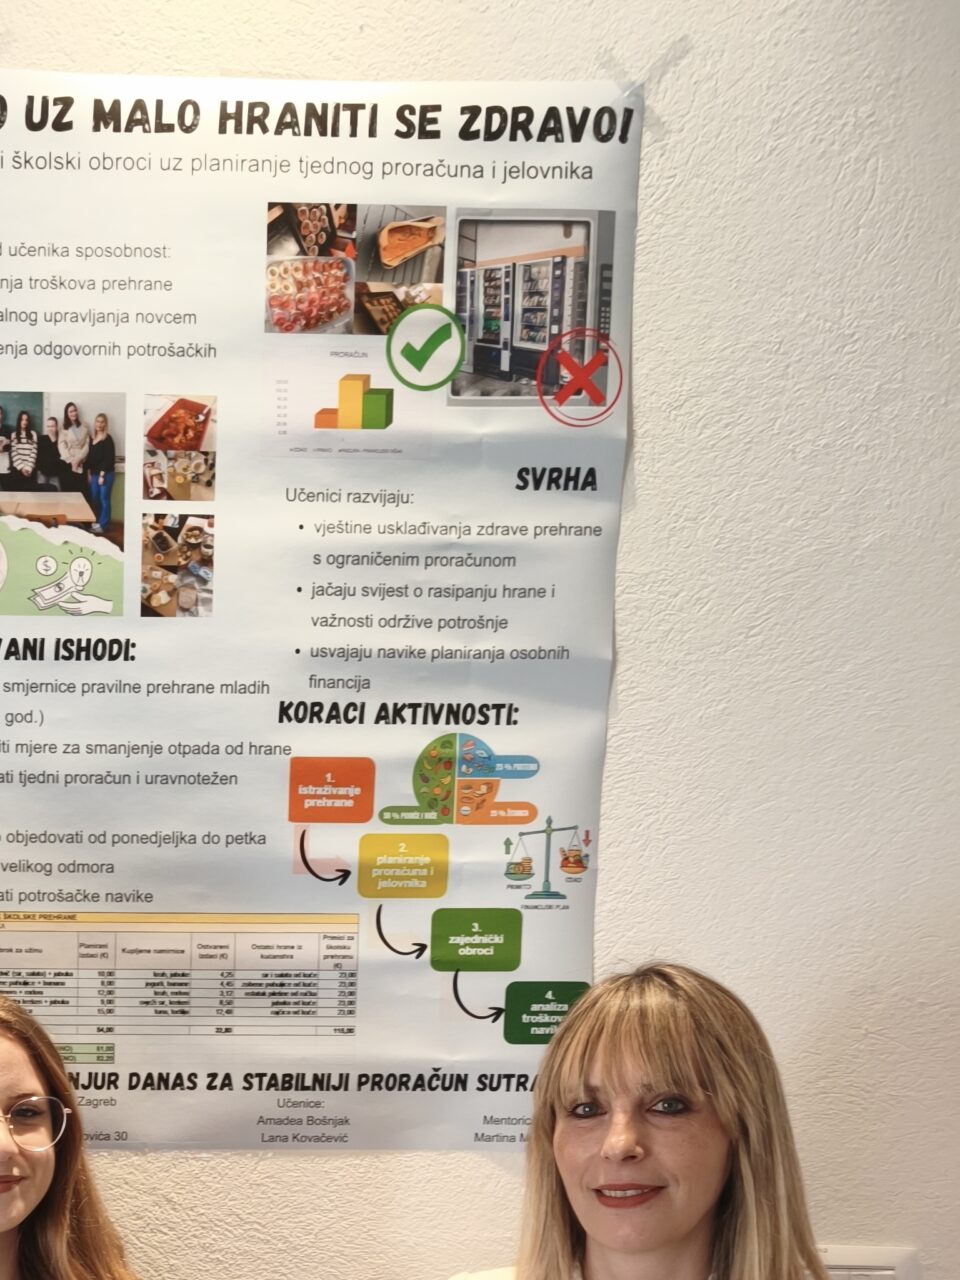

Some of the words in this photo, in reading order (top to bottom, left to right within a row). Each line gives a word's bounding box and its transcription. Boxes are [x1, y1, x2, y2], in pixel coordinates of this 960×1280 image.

[24, 95, 74, 132] UZ
[92, 98, 200, 134] MALO
[218, 100, 378, 138] HRANITI
[394, 104, 442, 140] SE
[458, 104, 634, 144] ZDRAVO!
[12, 150, 80, 170] školski
[88, 151, 151, 171] obroci
[160, 157, 182, 171] uz
[191, 153, 290, 178] planiranje
[298, 156, 373, 180] tjednog
[381, 158, 484, 179] proračuna
[492, 160, 496, 179] i
[501, 160, 593, 184] jelovnika
[8, 242, 69, 257] učenika
[75, 243, 171, 260] sposobnost:
[28, 275, 96, 290] troškova
[102, 276, 173, 293] prehrane
[43, 308, 129, 327] upravljanja
[135, 312, 196, 325] novcem
[33, 341, 121, 360] odgovornih
[127, 342, 216, 359] potrošačkih
[514, 466, 597, 491] SVRHA
[285, 487, 342, 503] Učenici
[346, 488, 414, 508] razvijaju:
[314, 519, 372, 537] vještine
[377, 520, 471, 540] usklađivanja
[476, 521, 528, 536] zdrave
[533, 522, 602, 539] prehrane
[312, 553, 322, 565] s
[326, 551, 419, 569] ograničenim
[424, 552, 516, 570] proračunom
[54, 637, 136, 661] ISHODI:
[2, 678, 76, 697] smjernice
[81, 679, 142, 697] pravilne
[146, 679, 215, 697] prehrane
[220, 680, 270, 694] mladih
[278, 700, 366, 724] KORACI
[373, 702, 519, 726] AKTIVNOSTI:
[15, 739, 58, 757] mjere
[62, 743, 80, 754] za
[85, 740, 163, 758] smanjenje
[167, 741, 220, 758] otpada
[224, 741, 244, 755] od
[249, 742, 291, 755] hrane
[67, 1071, 119, 1091] NJUR
[128, 1071, 198, 1091] DANAS
[206, 1072, 234, 1091] ZA
[242, 1072, 350, 1091] STABILNIJI
[357, 1069, 468, 1092] PRORAČUN
[476, 1073, 539, 1092] SUTR
[276, 1098, 325, 1108] Učenice:
[256, 1115, 303, 1126] Amadea
[306, 1115, 350, 1128] Bošnjak
[260, 1132, 289, 1143] Lana
[291, 1132, 348, 1143] Kovačević
